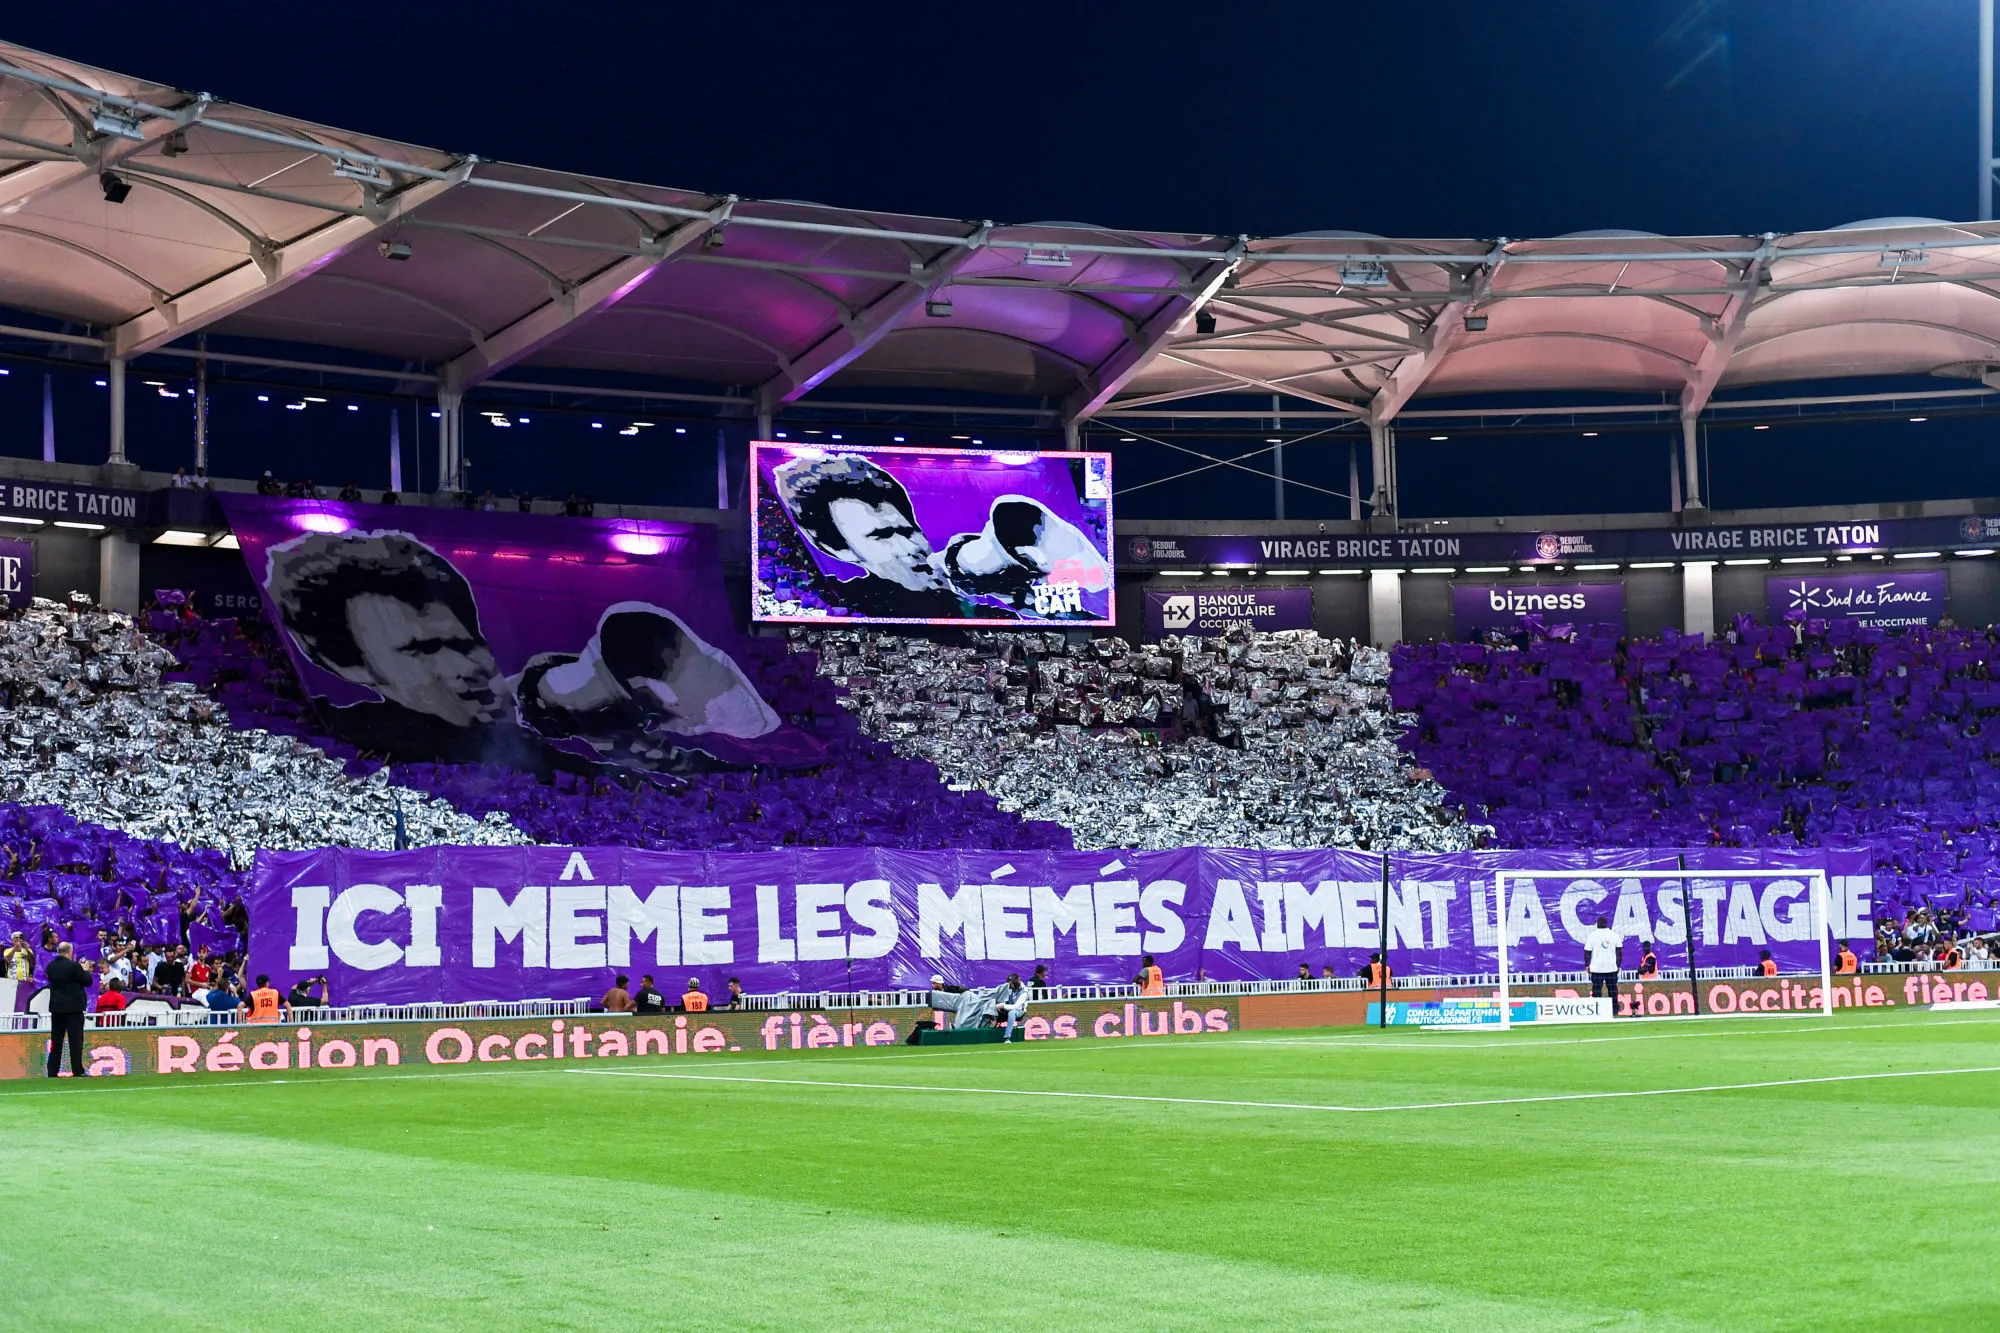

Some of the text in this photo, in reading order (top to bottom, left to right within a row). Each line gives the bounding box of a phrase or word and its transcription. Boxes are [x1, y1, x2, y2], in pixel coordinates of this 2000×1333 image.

[13, 486, 69, 512] BRICE
[75, 492, 136, 518] TATON
[1671, 525, 1880, 550] VIRAGE BRICE TATON
[1153, 549, 1187, 558] TOUJOURS.
[1261, 539, 1460, 558] VIRAGE BRICE TATON
[1560, 544, 1595, 554] TOUJOURS.
[1034, 592, 1082, 615] CAM
[1199, 594, 1256, 606] BANQUE
[1490, 590, 1586, 613] bizness
[1822, 582, 1932, 608] Sud de France
[1199, 605, 1276, 617] POPULAIRE
[1199, 619, 1253, 629] OCCITANE
[1870, 617, 1928, 628] L'OCCITANIE
[289, 851, 1874, 970] ICI MÊME LES MÉMÉS AIMENT LA CASTAGNE
[1904, 974, 1988, 1005] fière
[1405, 1015, 1483, 1025] HAUTE-GARONNE.FR
[1406, 1007, 1514, 1017] CONSEIL DÉPARTEMENTL
[157, 1027, 401, 1075] Région
[761, 1012, 897, 1049] fière
[1094, 1002, 1229, 1038] clubs
